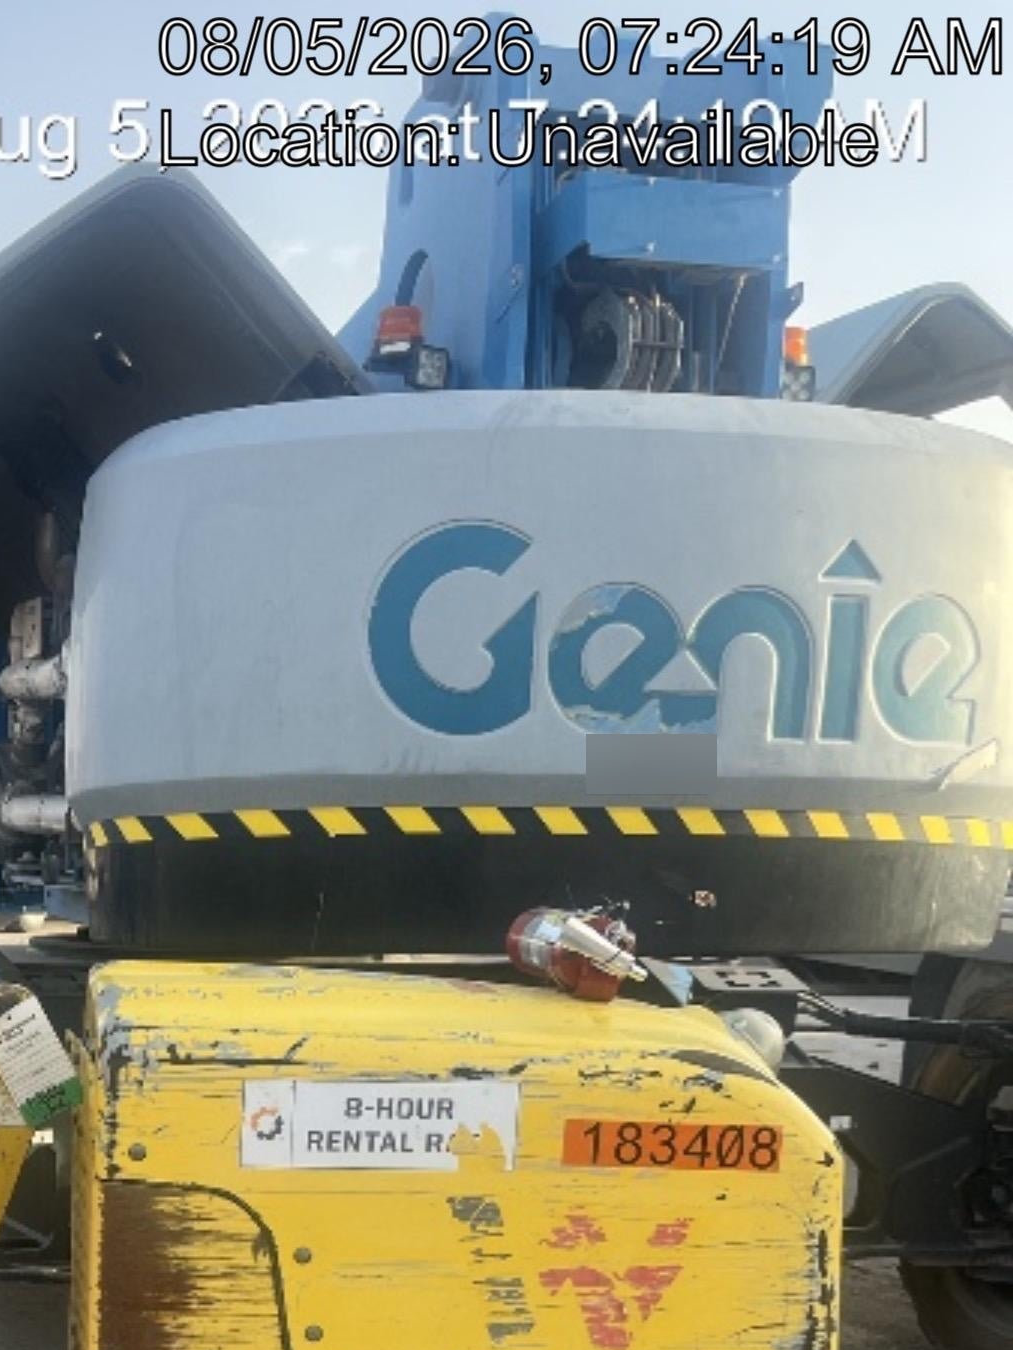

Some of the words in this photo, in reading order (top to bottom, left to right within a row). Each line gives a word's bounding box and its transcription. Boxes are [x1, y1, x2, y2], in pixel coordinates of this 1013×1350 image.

[365, 518, 981, 746] Genie
[343, 1096, 455, 1121] 8-HOUR
[306, 1130, 415, 1153] RENTAL
[583, 1120, 778, 1171] 183408
